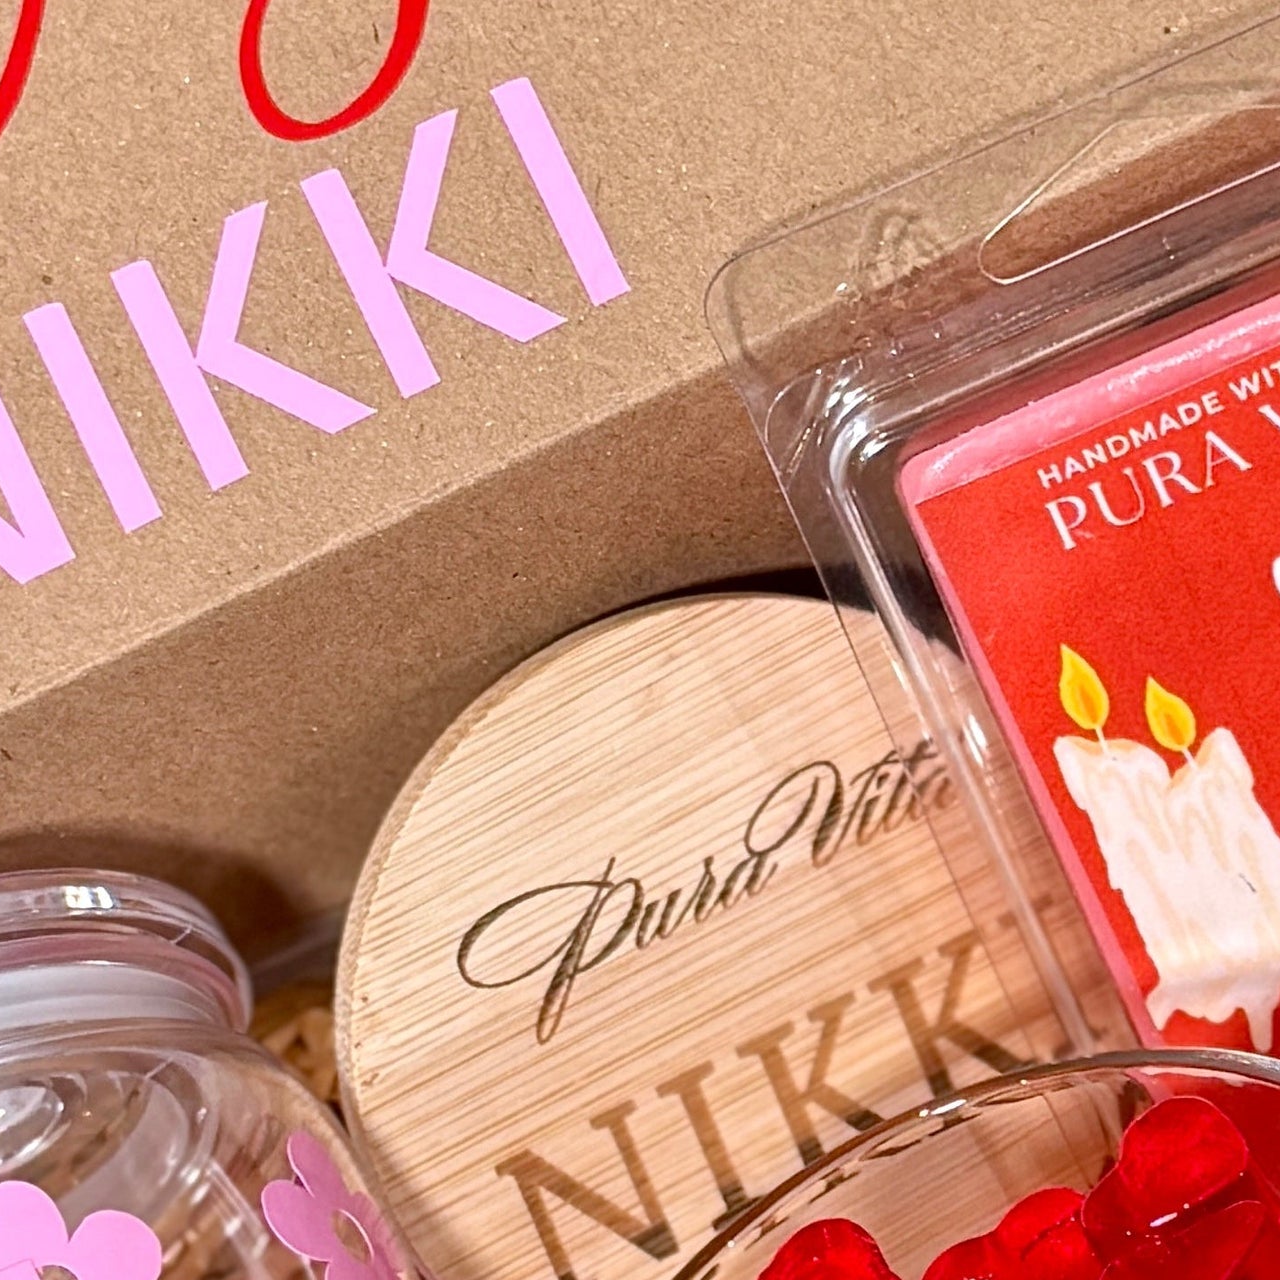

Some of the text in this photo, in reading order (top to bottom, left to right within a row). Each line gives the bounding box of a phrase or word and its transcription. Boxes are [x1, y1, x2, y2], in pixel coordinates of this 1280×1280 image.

[1037, 390, 1225, 489] HANDMADE
[1044, 429, 1253, 550] PURA
[456, 853, 778, 1046] Pura
